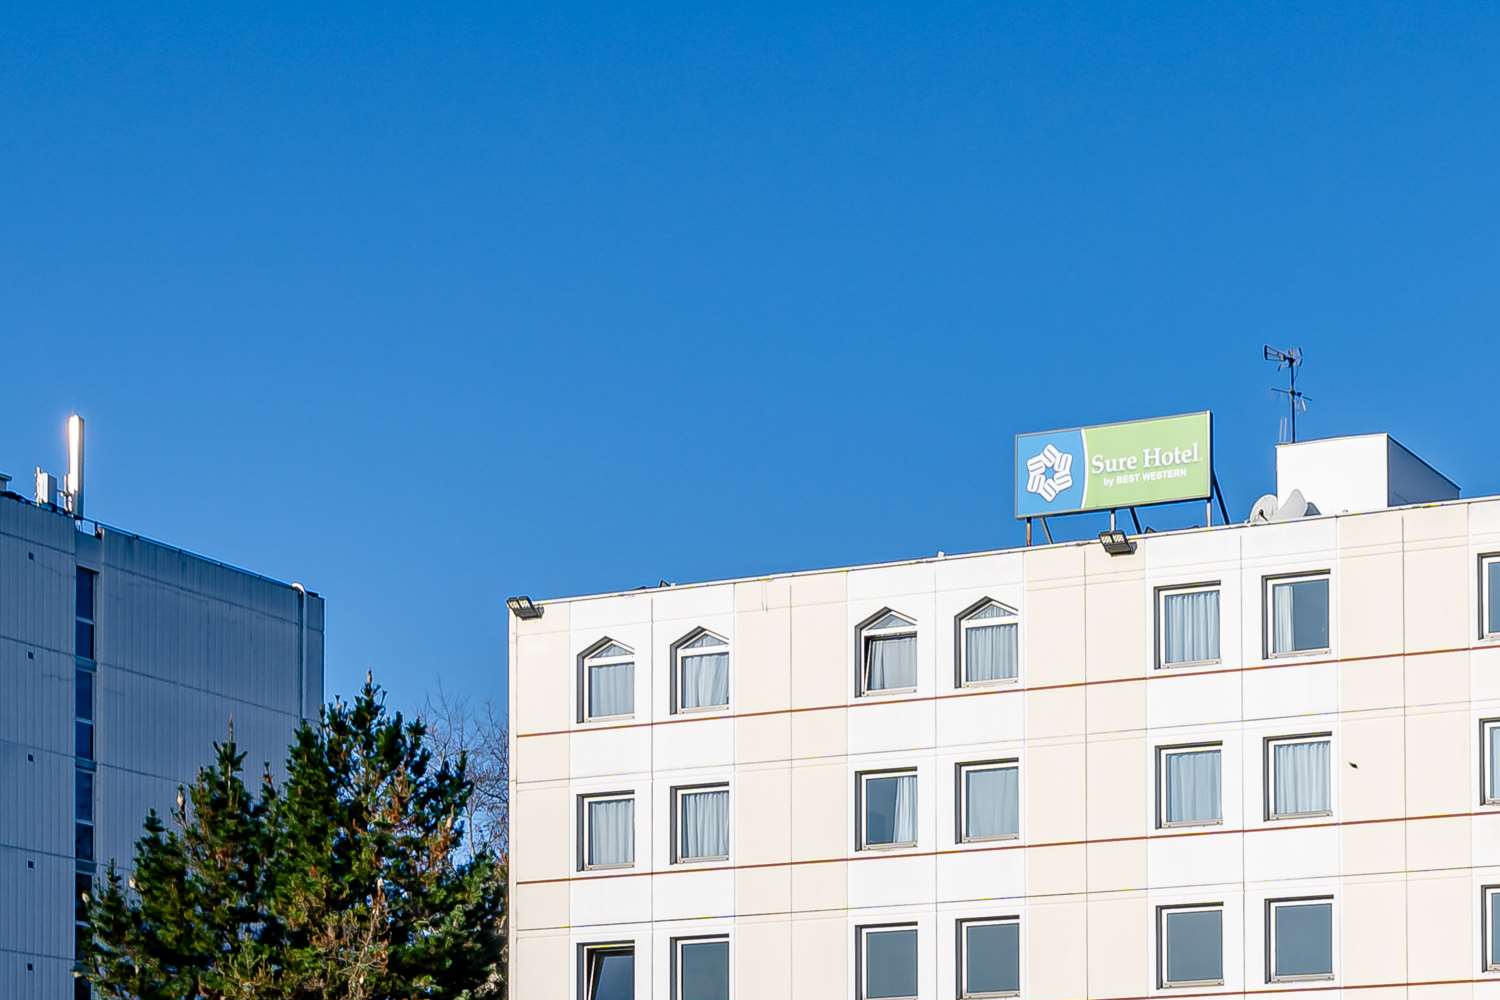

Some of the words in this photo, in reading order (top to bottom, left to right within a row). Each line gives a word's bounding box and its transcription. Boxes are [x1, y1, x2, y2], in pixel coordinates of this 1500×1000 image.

[1091, 453, 1138, 475] Sure
[1142, 441, 1200, 468] Hotel
[1103, 477, 1114, 488] by
[1115, 472, 1140, 485] BEST
[1142, 468, 1187, 481] WESTERN
